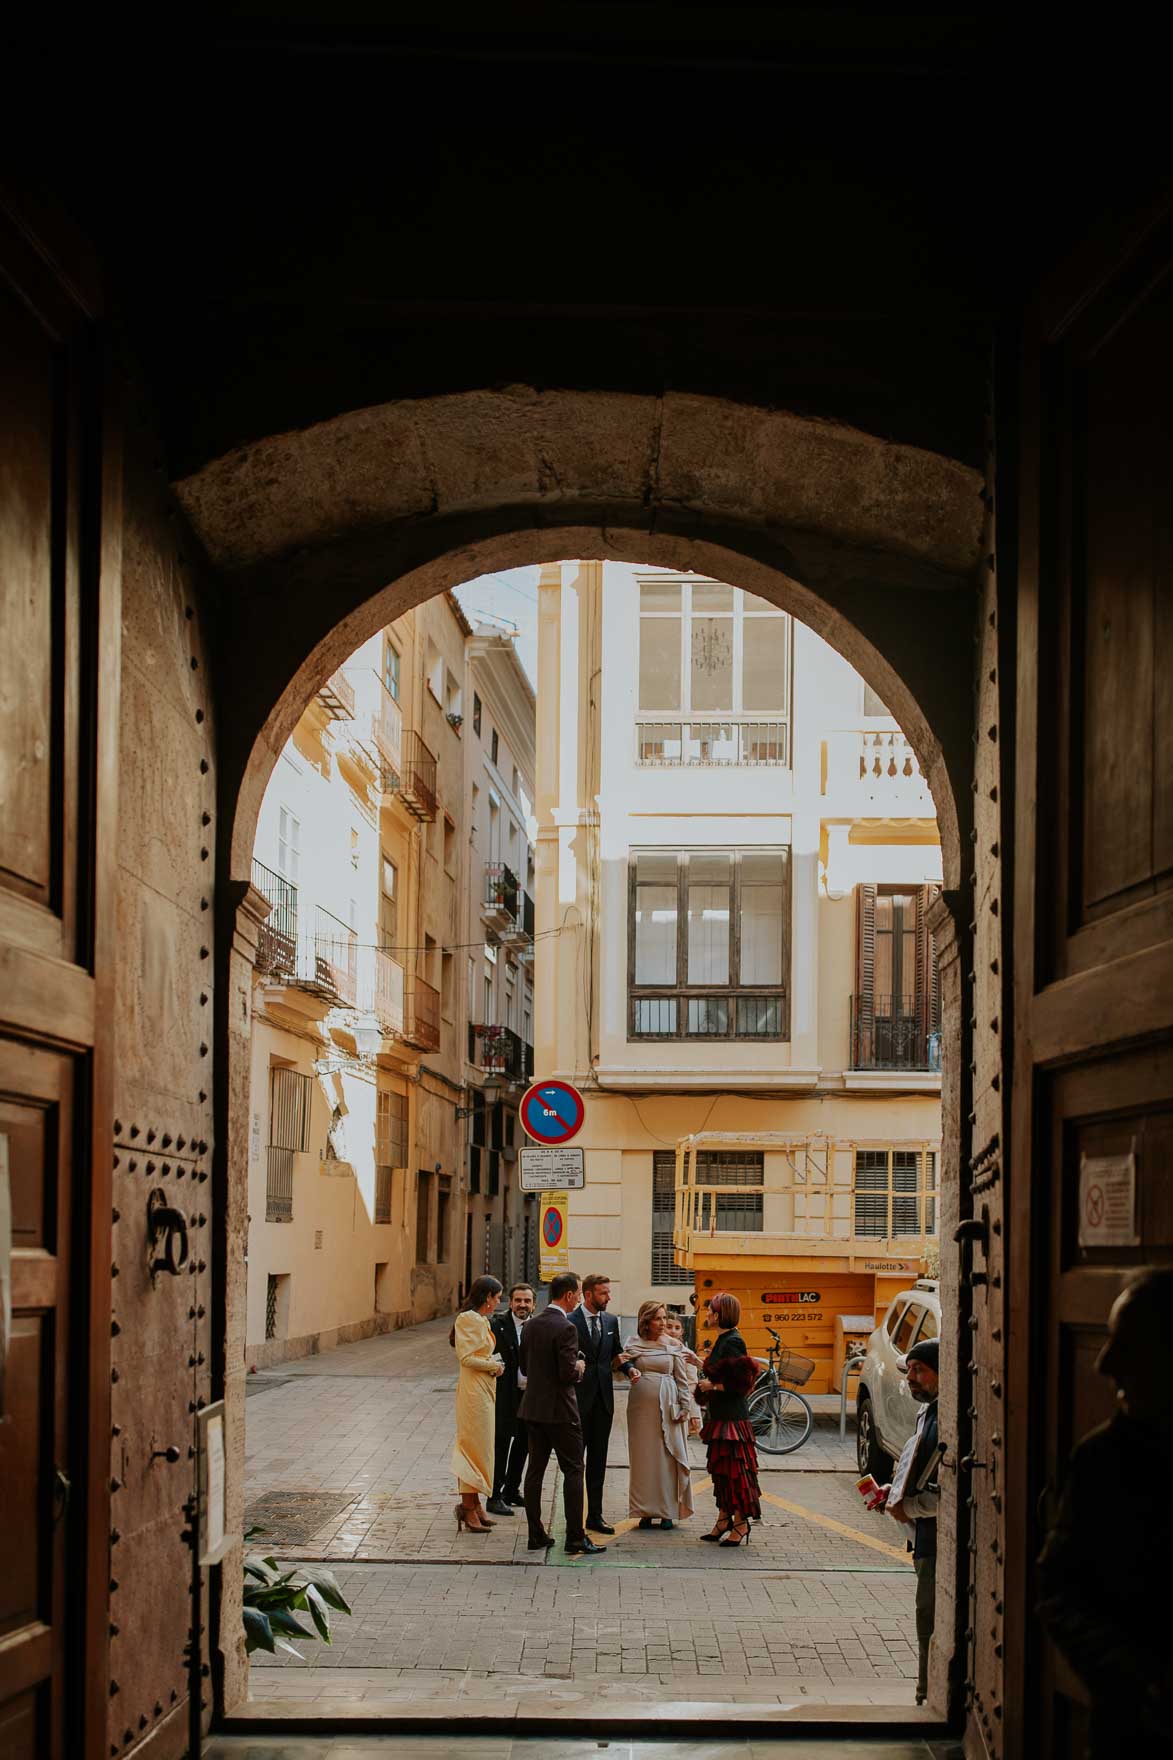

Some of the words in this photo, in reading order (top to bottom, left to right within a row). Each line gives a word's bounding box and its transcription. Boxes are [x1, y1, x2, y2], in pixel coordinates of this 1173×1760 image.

[543, 1109, 557, 1117] 6m
[864, 1261, 896, 1270] Haulotte
[774, 1313, 789, 1321] 960
[791, 1313, 805, 1321] 223
[807, 1313, 823, 1321] 572
